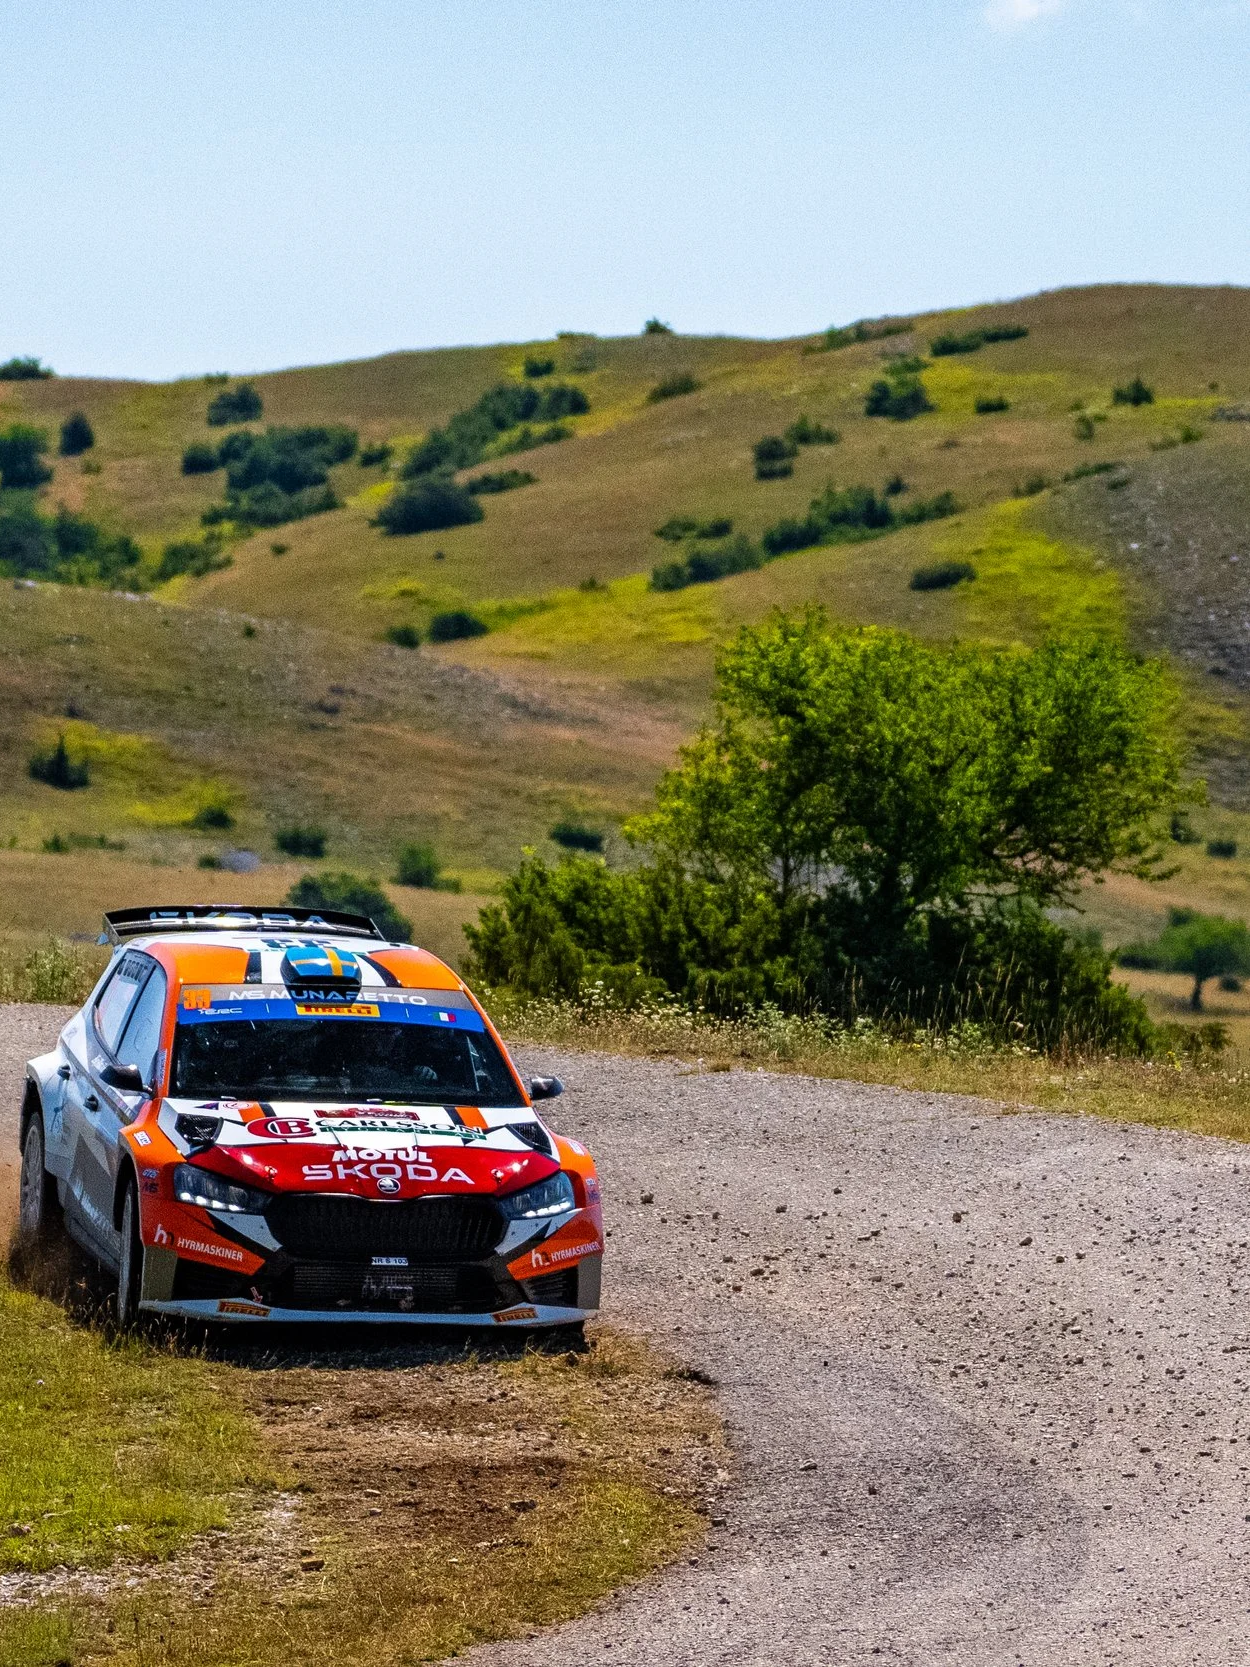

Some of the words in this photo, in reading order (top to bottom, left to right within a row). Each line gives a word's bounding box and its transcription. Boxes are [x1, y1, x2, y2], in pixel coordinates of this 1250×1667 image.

[229, 990, 263, 1000] MS
[270, 990, 427, 1006] MUNARETTO
[304, 1003, 372, 1015] PIRELLI
[315, 1119, 484, 1135] CARLSSON
[332, 1147, 433, 1163] MOTUL
[178, 1237, 243, 1262] HYRMASKINER
[552, 1241, 600, 1262] HYRMASKINER
